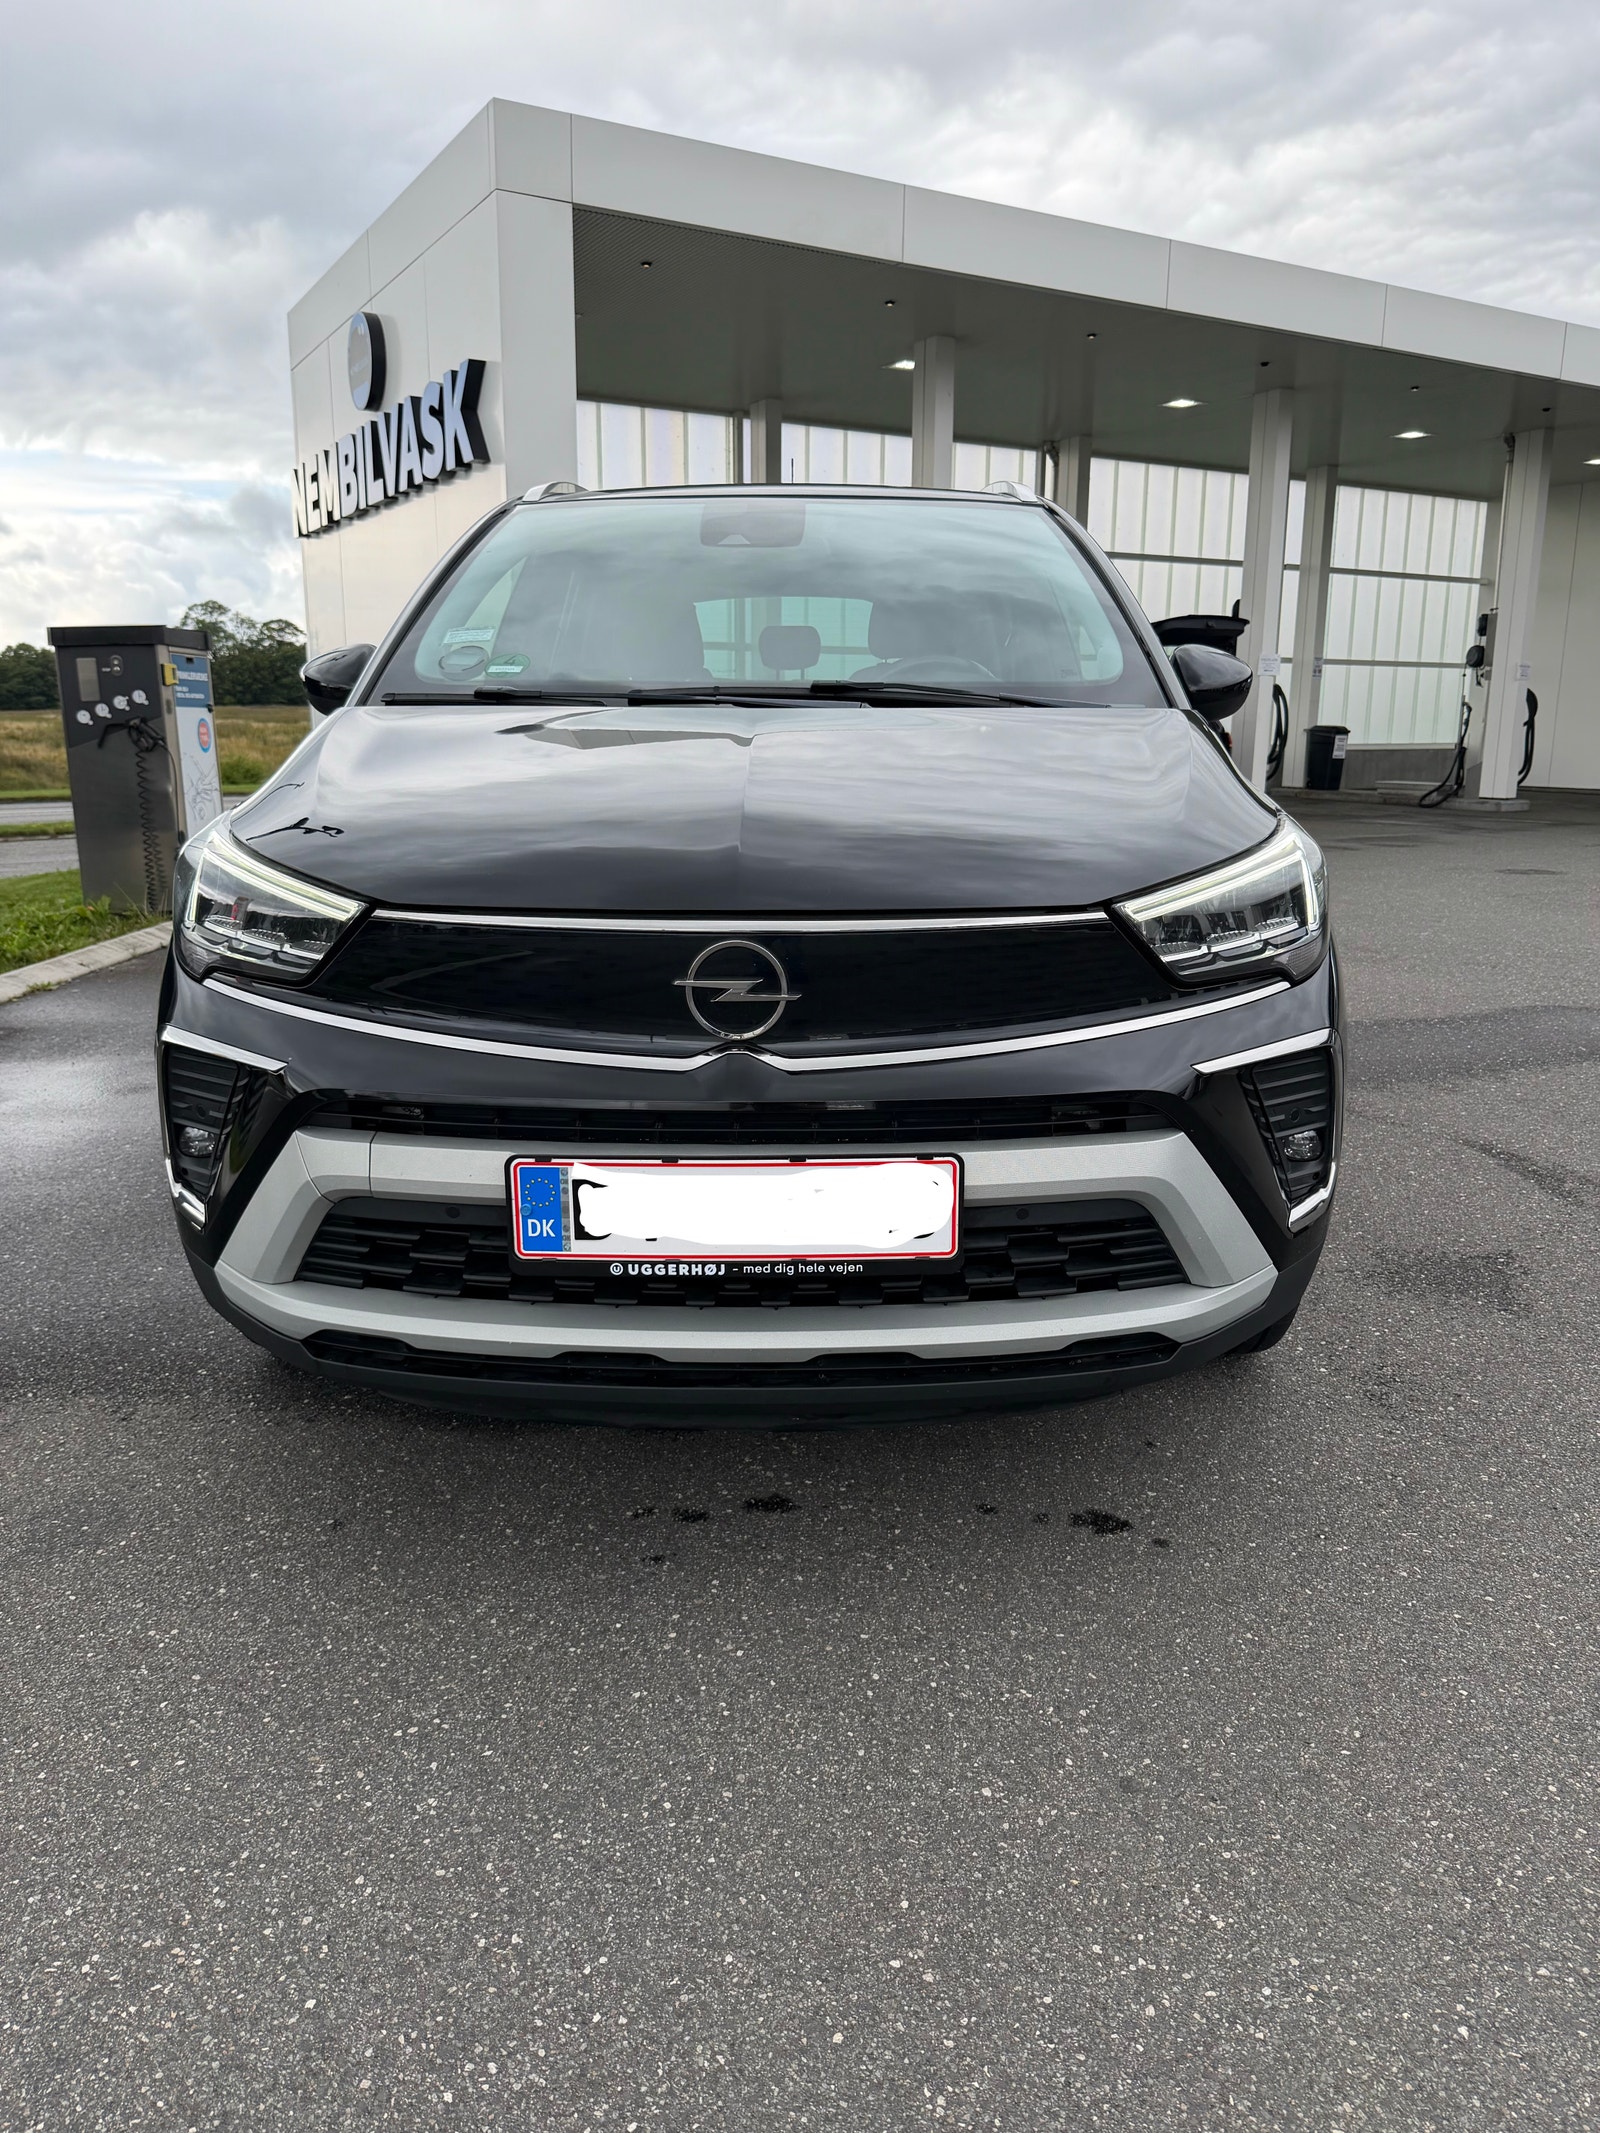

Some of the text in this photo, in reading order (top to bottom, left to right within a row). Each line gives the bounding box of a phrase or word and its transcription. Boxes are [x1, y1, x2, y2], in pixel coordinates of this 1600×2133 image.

[292, 358, 488, 538] NEMBILVASK
[527, 1218, 556, 1238] DK
[627, 1263, 726, 1276] UGGERHØJ
[743, 1263, 771, 1274] med
[774, 1263, 795, 1276] dig
[798, 1262, 826, 1273] hele
[828, 1262, 864, 1275] vejen
